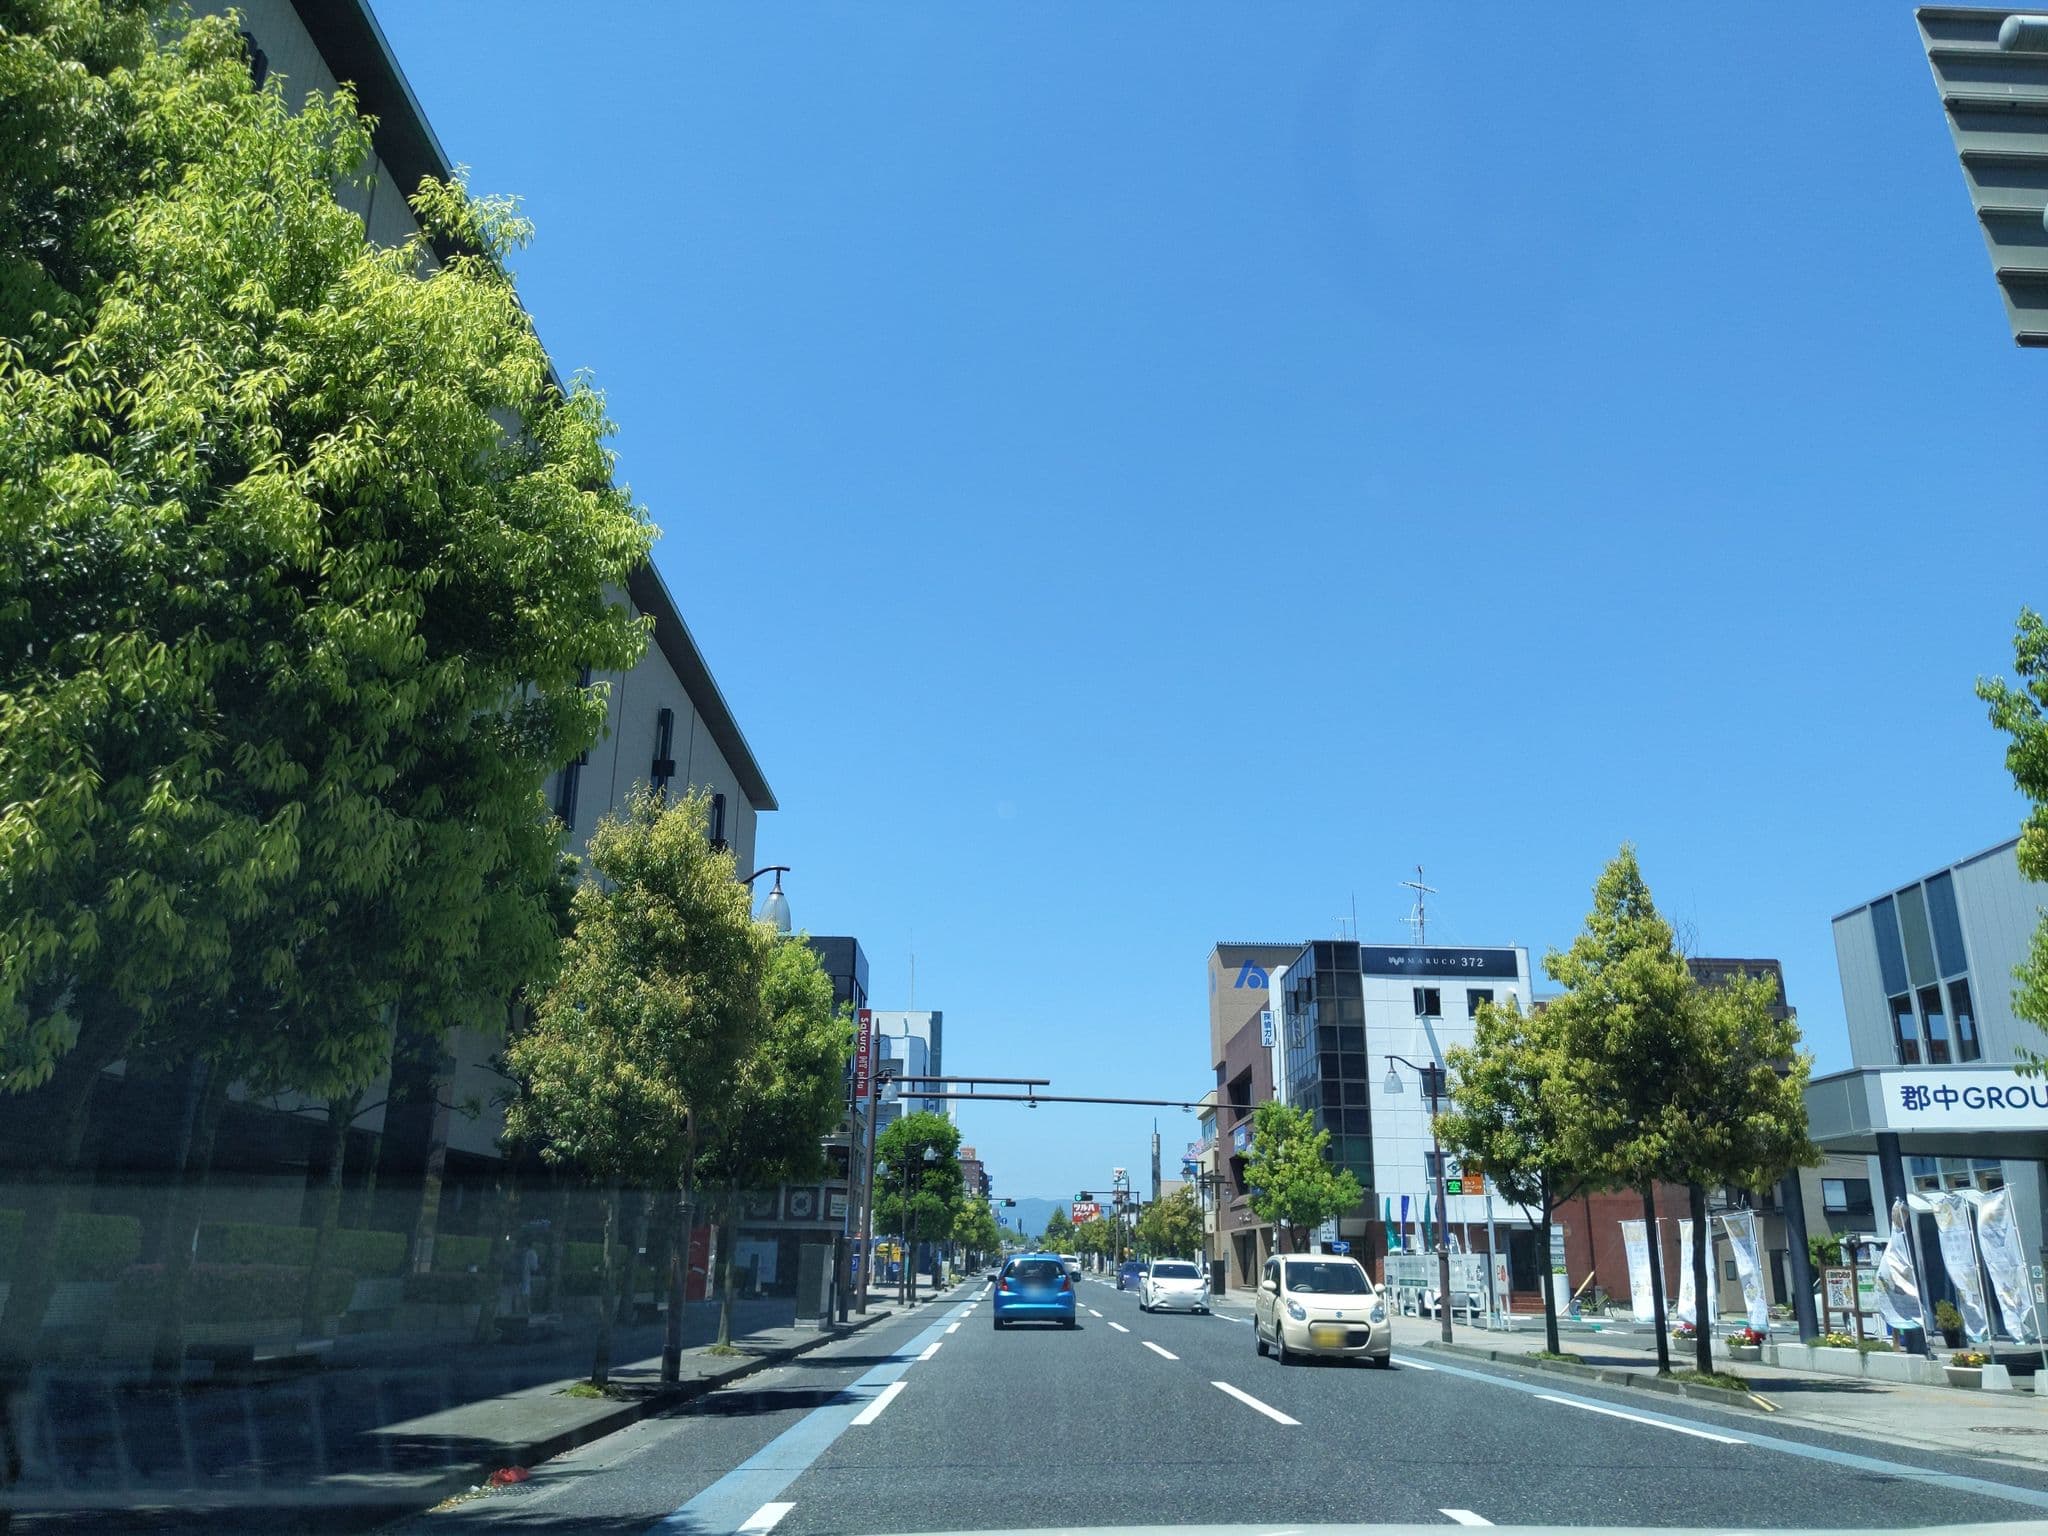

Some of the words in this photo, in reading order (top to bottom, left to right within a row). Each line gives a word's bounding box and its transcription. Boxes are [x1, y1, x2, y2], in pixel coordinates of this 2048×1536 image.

[1407, 957, 1456, 967] MARUCO
[1461, 957, 1485, 968] 372
[859, 1017, 869, 1053] Sakura
[1073, 1203, 1095, 1211] ツルハ
